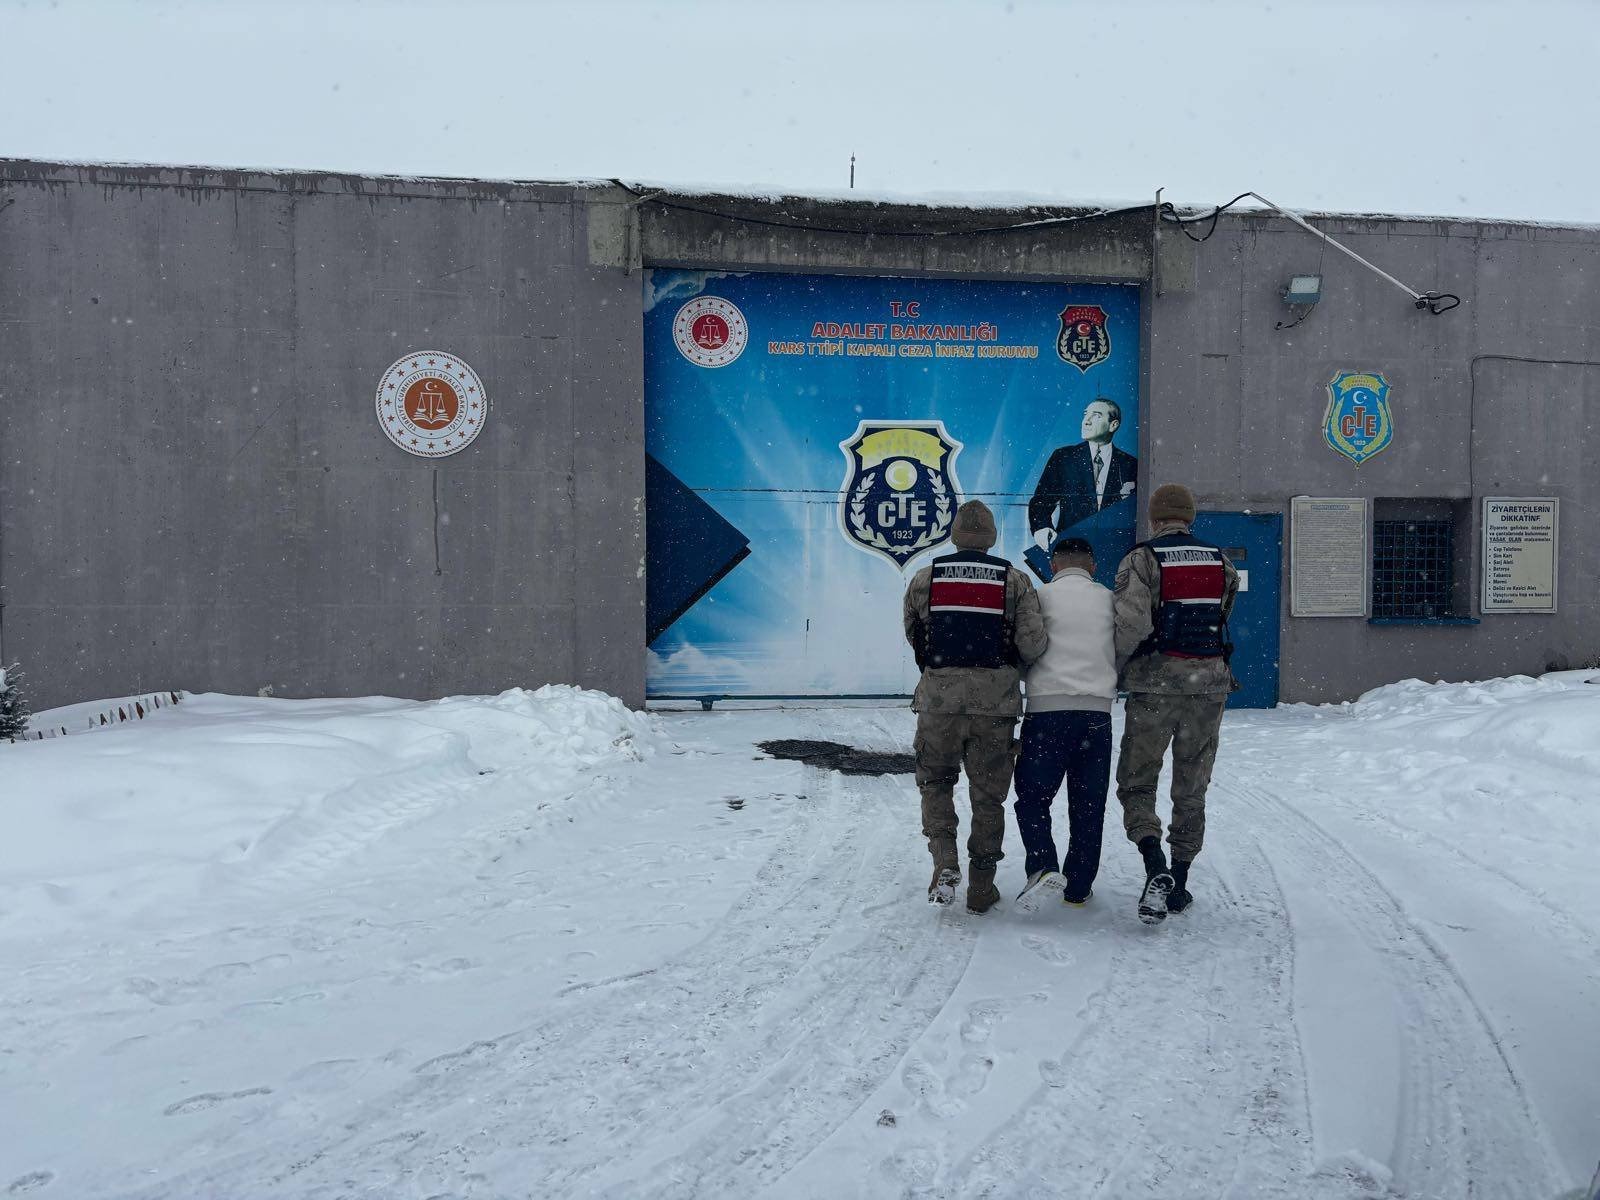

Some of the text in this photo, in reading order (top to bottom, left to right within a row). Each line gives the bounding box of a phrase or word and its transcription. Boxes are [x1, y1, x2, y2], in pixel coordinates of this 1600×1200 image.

[811, 322, 998, 341] ADALET BAKANLIĞI
[768, 341, 805, 355] KARS
[817, 340, 844, 356] TİPİ
[847, 343, 897, 357] KAPALI
[899, 345, 933, 357] CEZA
[935, 342, 974, 358] İNFAZ
[977, 345, 1039, 358] KURUMU
[397, 371, 436, 402] CUMHURİYETİ
[438, 373, 462, 393] ADALET
[1491, 505, 1551, 514] ZİYARETÇİLERİN
[891, 530, 913, 539] 1923
[1164, 550, 1215, 562] JANDARMA
[941, 566, 998, 580] JANDARMA
